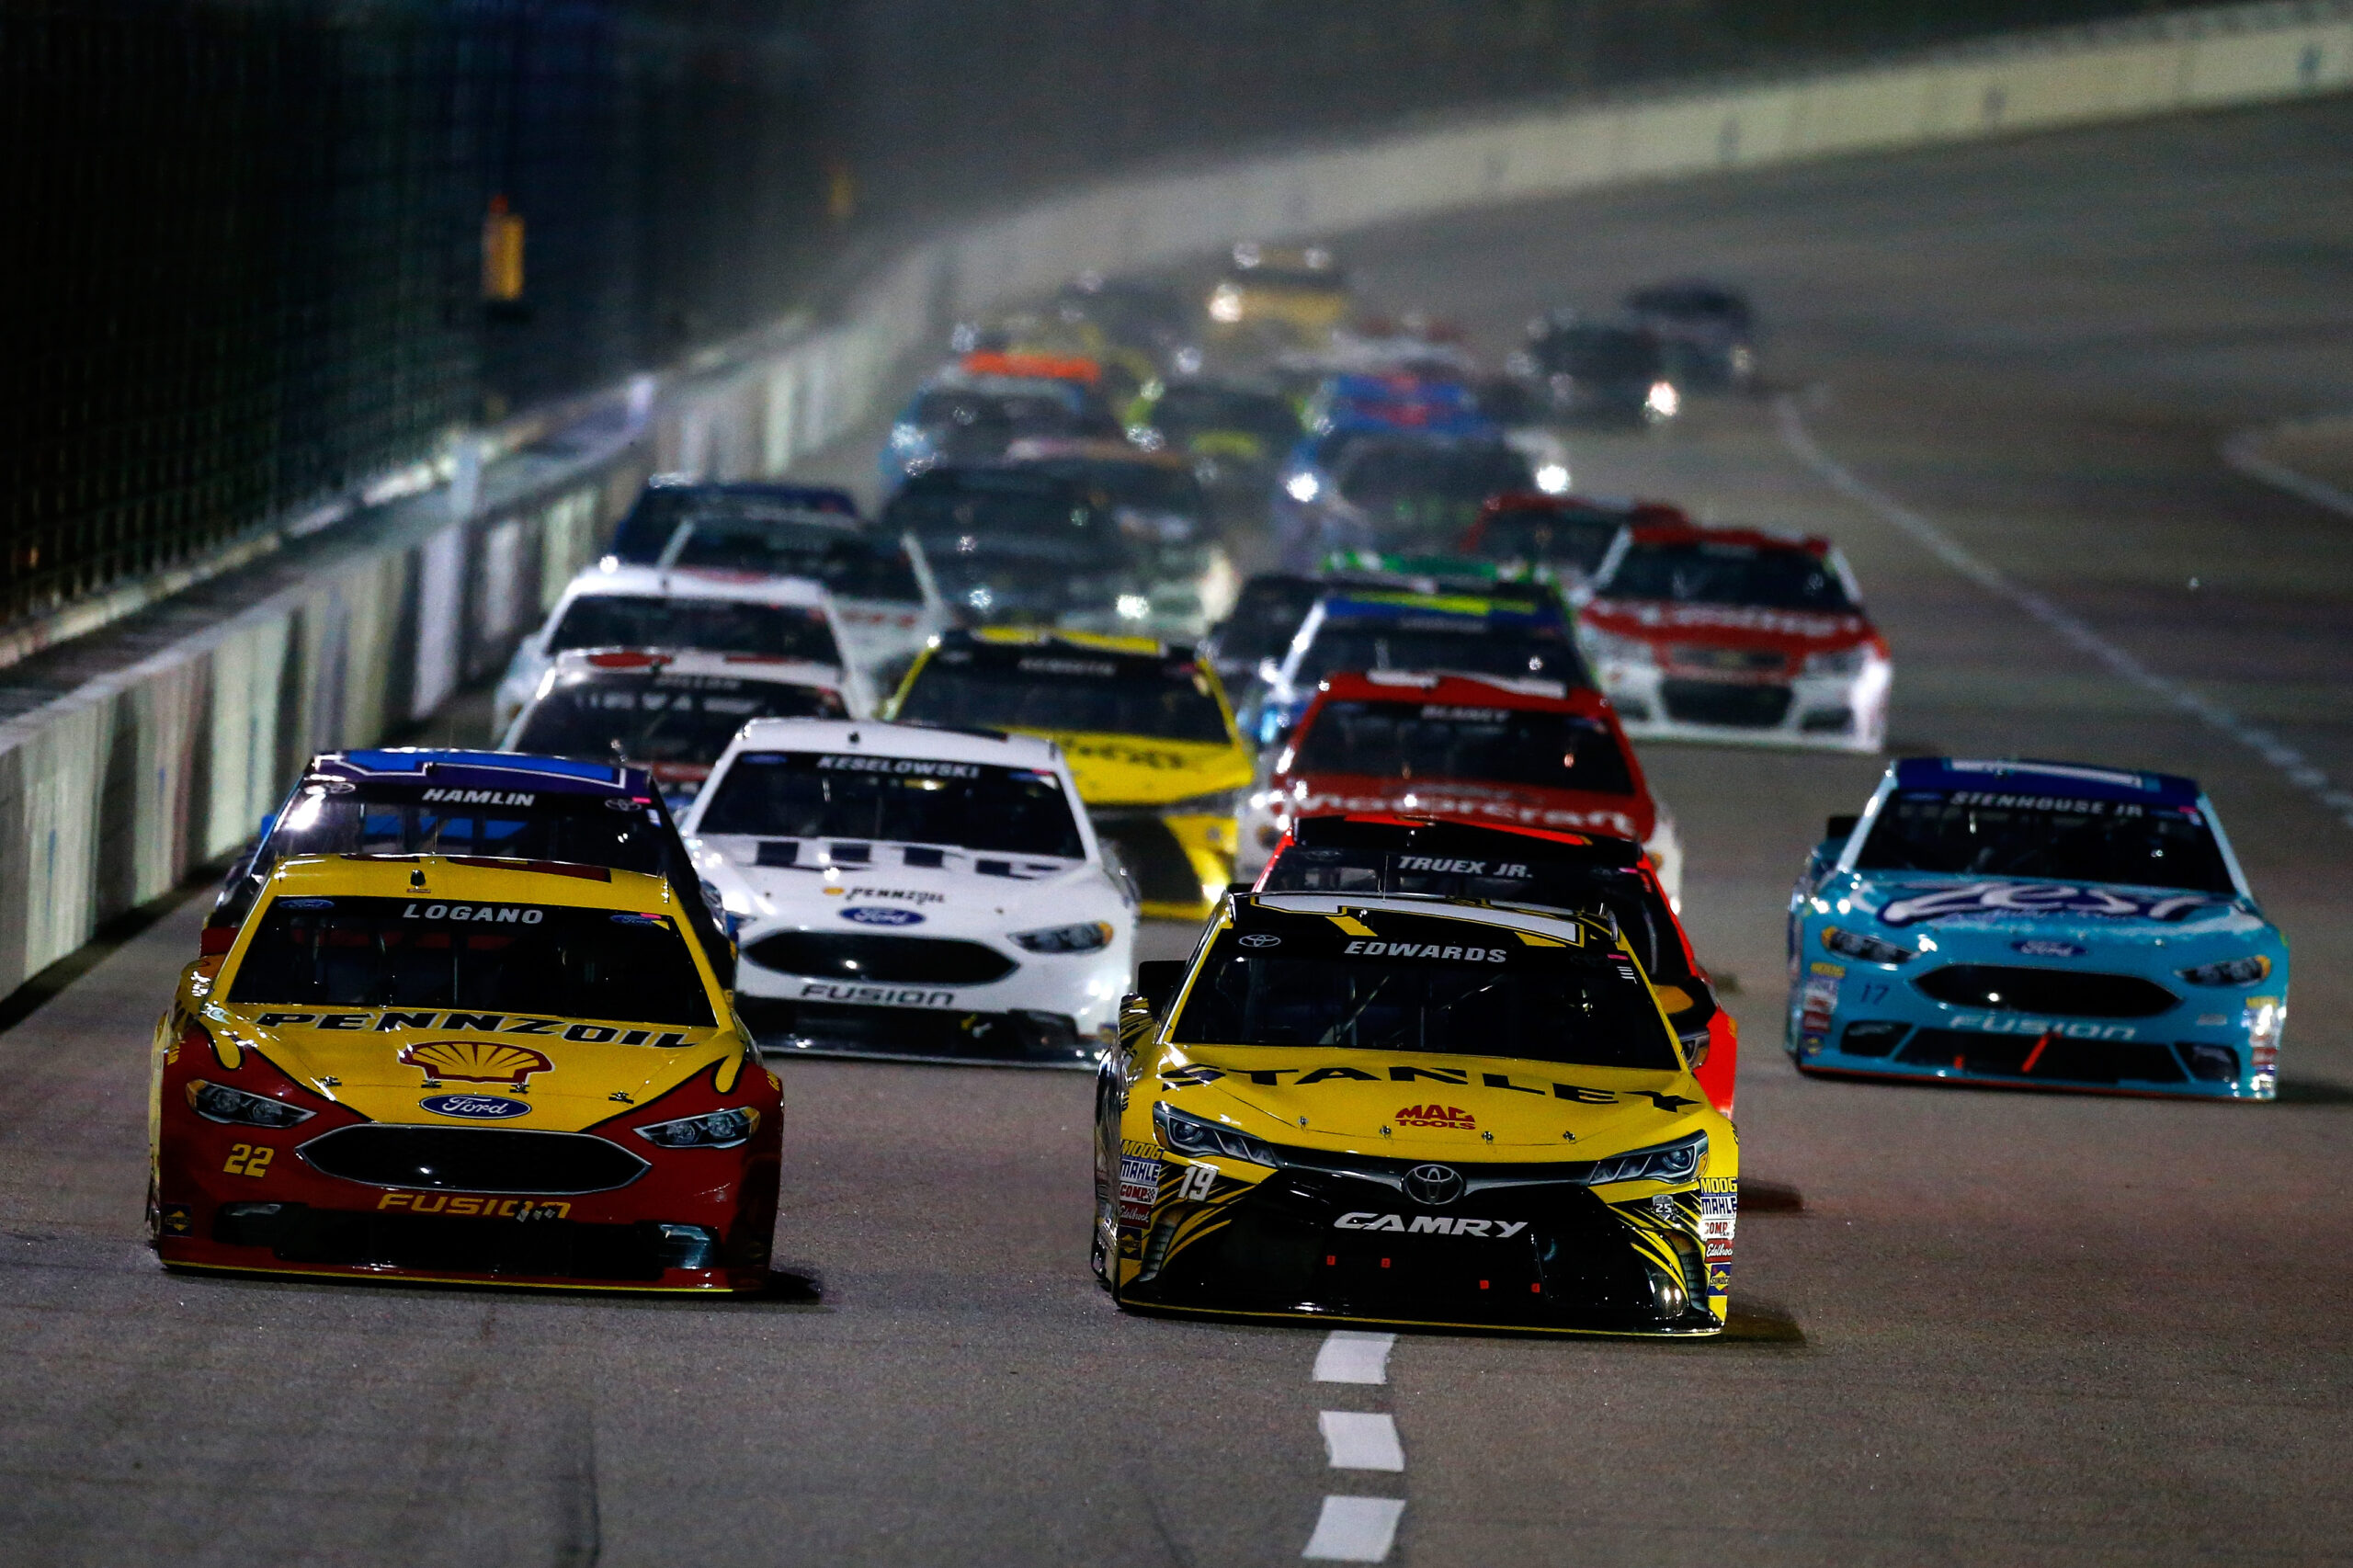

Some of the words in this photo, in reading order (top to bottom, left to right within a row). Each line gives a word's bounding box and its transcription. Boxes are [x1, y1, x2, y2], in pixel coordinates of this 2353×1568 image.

[817, 756, 981, 779] KESELOWSKI
[423, 788, 535, 806] HAMLIN
[1949, 790, 2106, 814] STENHOUSE
[2114, 803, 2143, 817] JR
[1398, 856, 1484, 876] TRUEX
[1493, 862, 1534, 879] JR.
[403, 903, 543, 925] LOGANO
[853, 907, 910, 926] Ford
[1345, 940, 1507, 964] EDWARDS
[801, 983, 955, 1006] FUSION
[1861, 984, 1890, 1004] 17
[255, 1011, 700, 1050] PENNZOIL
[1949, 1014, 2136, 1040] FUSION
[1161, 1062, 1702, 1114] STANLEY
[441, 1095, 510, 1115] Ford
[222, 1142, 275, 1177] 22
[1121, 1140, 1164, 1160] MOOG
[1121, 1160, 1161, 1182] MAHLE
[1120, 1184, 1148, 1199] COMP
[1177, 1165, 1218, 1201] 19
[1700, 1177, 1738, 1194] MOOG
[376, 1193, 572, 1219] FUSION
[1655, 1203, 1673, 1213] 25
[1700, 1198, 1738, 1215] MAHLE
[1334, 1211, 1529, 1238] CAMRY
[1706, 1243, 1733, 1257] Edelbroc
